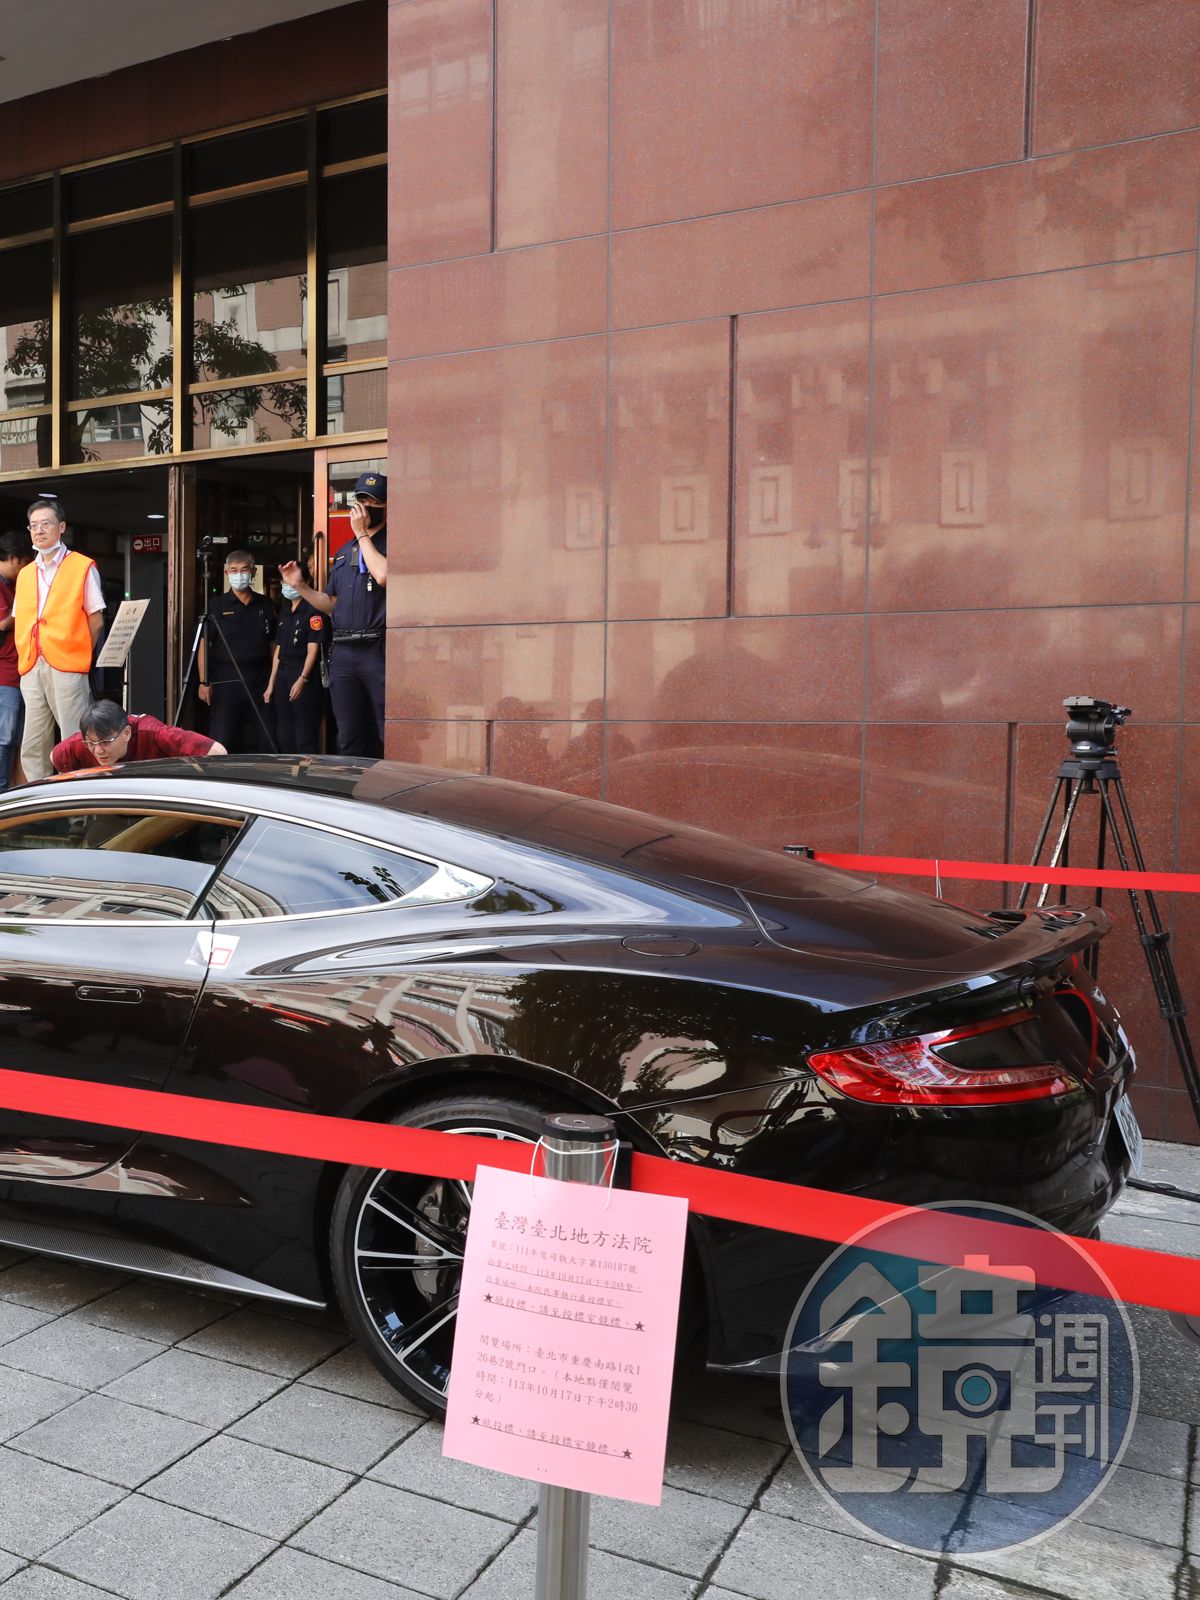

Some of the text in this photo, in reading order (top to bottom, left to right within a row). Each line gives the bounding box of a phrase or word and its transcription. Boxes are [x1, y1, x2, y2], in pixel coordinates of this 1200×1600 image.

[493, 1210, 654, 1254] 臺灣臺北地方法院
